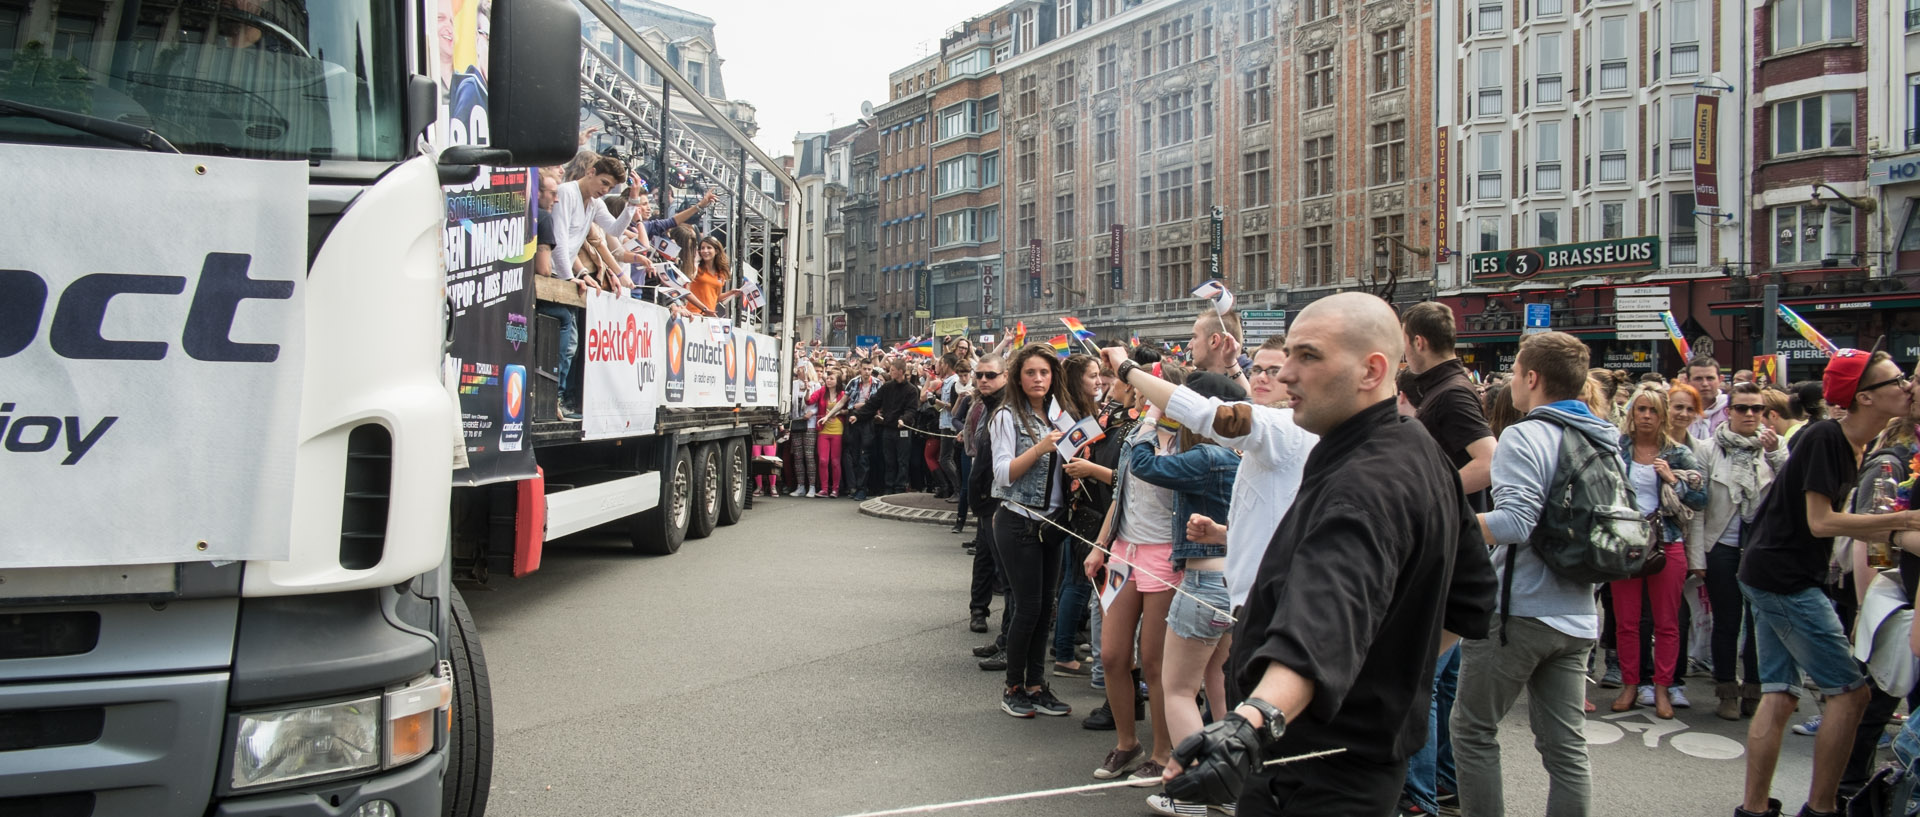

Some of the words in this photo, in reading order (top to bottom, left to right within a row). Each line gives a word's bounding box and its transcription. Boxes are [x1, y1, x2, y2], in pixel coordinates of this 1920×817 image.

[1698, 108, 1708, 160] balladins
[1889, 162, 1920, 180] HO
[1696, 185, 1716, 194] HÔTEL
[471, 216, 525, 268] MANSON
[1472, 257, 1498, 274] LES
[1516, 255, 1528, 274] 3
[502, 267, 523, 294] ROXX
[984, 266, 993, 315] HOTEL
[686, 340, 722, 365] contact
